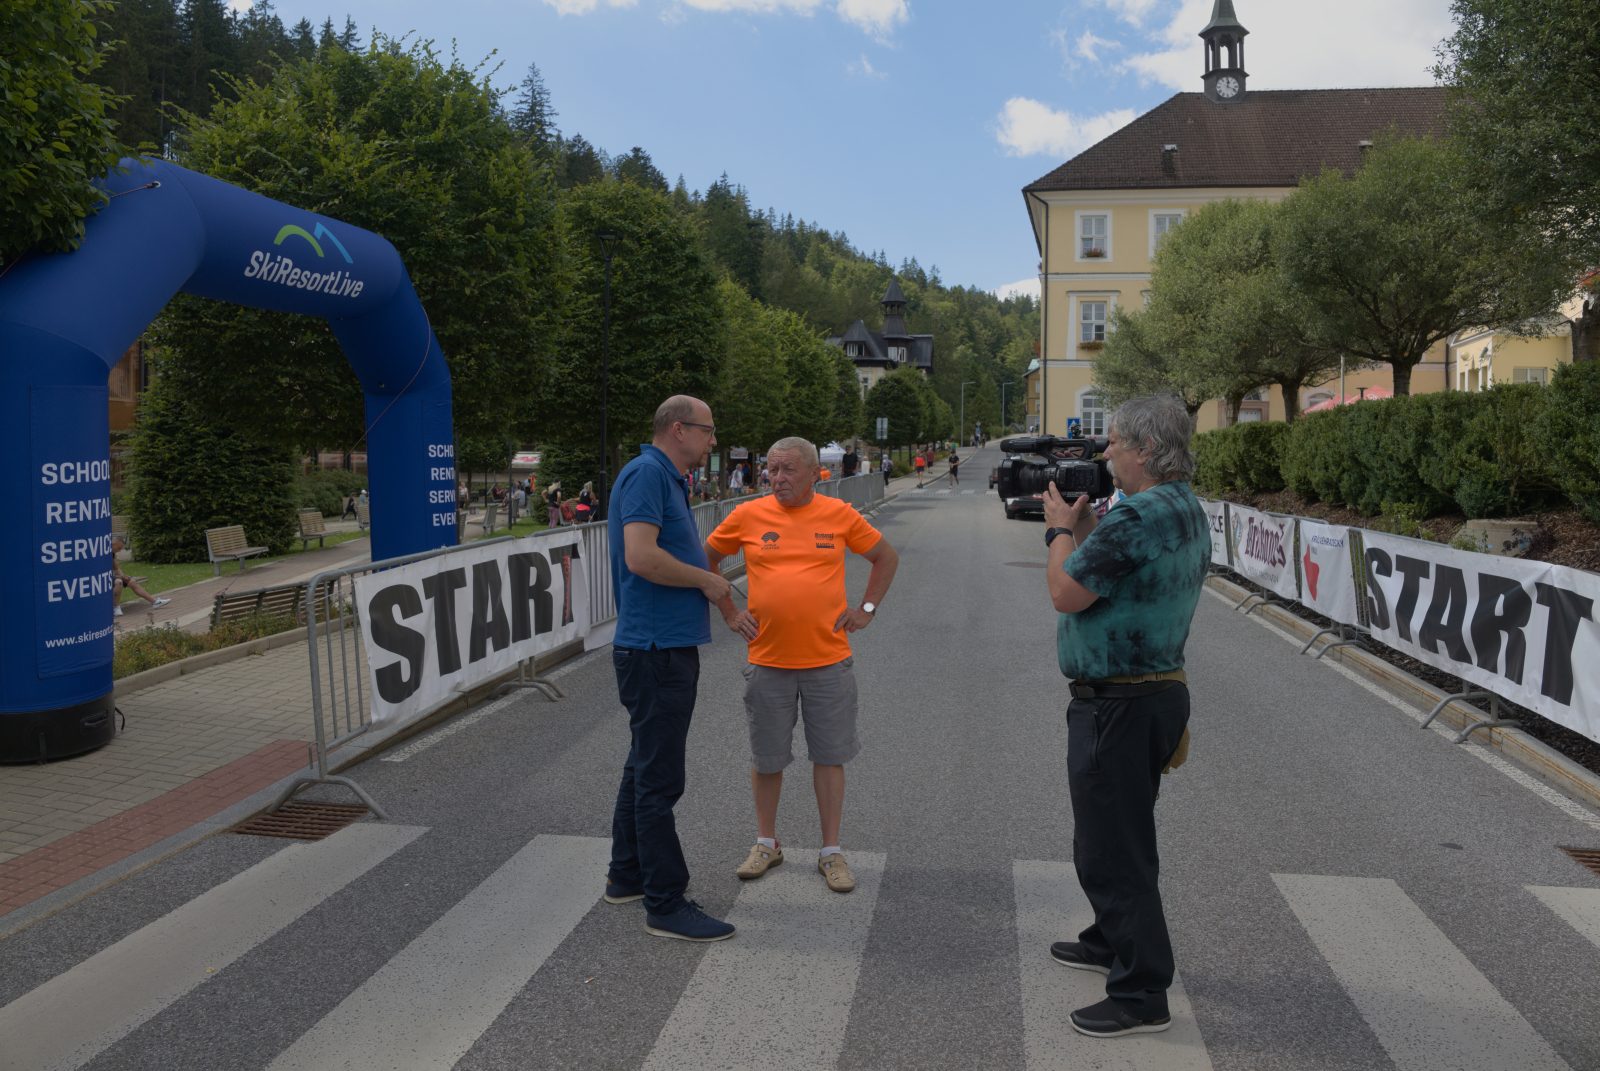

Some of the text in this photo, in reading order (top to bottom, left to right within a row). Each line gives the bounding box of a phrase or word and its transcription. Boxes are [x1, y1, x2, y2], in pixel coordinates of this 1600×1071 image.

[244, 250, 364, 298] SkiResortLive
[428, 444, 454, 458] SCHO
[41, 460, 111, 485] SCHOOL
[430, 467, 455, 481] RENT
[46, 497, 111, 524] RENTAL
[432, 511, 457, 527] EVEN
[47, 569, 113, 602] EVENTS
[369, 543, 580, 704] START
[1365, 547, 1595, 707] START
